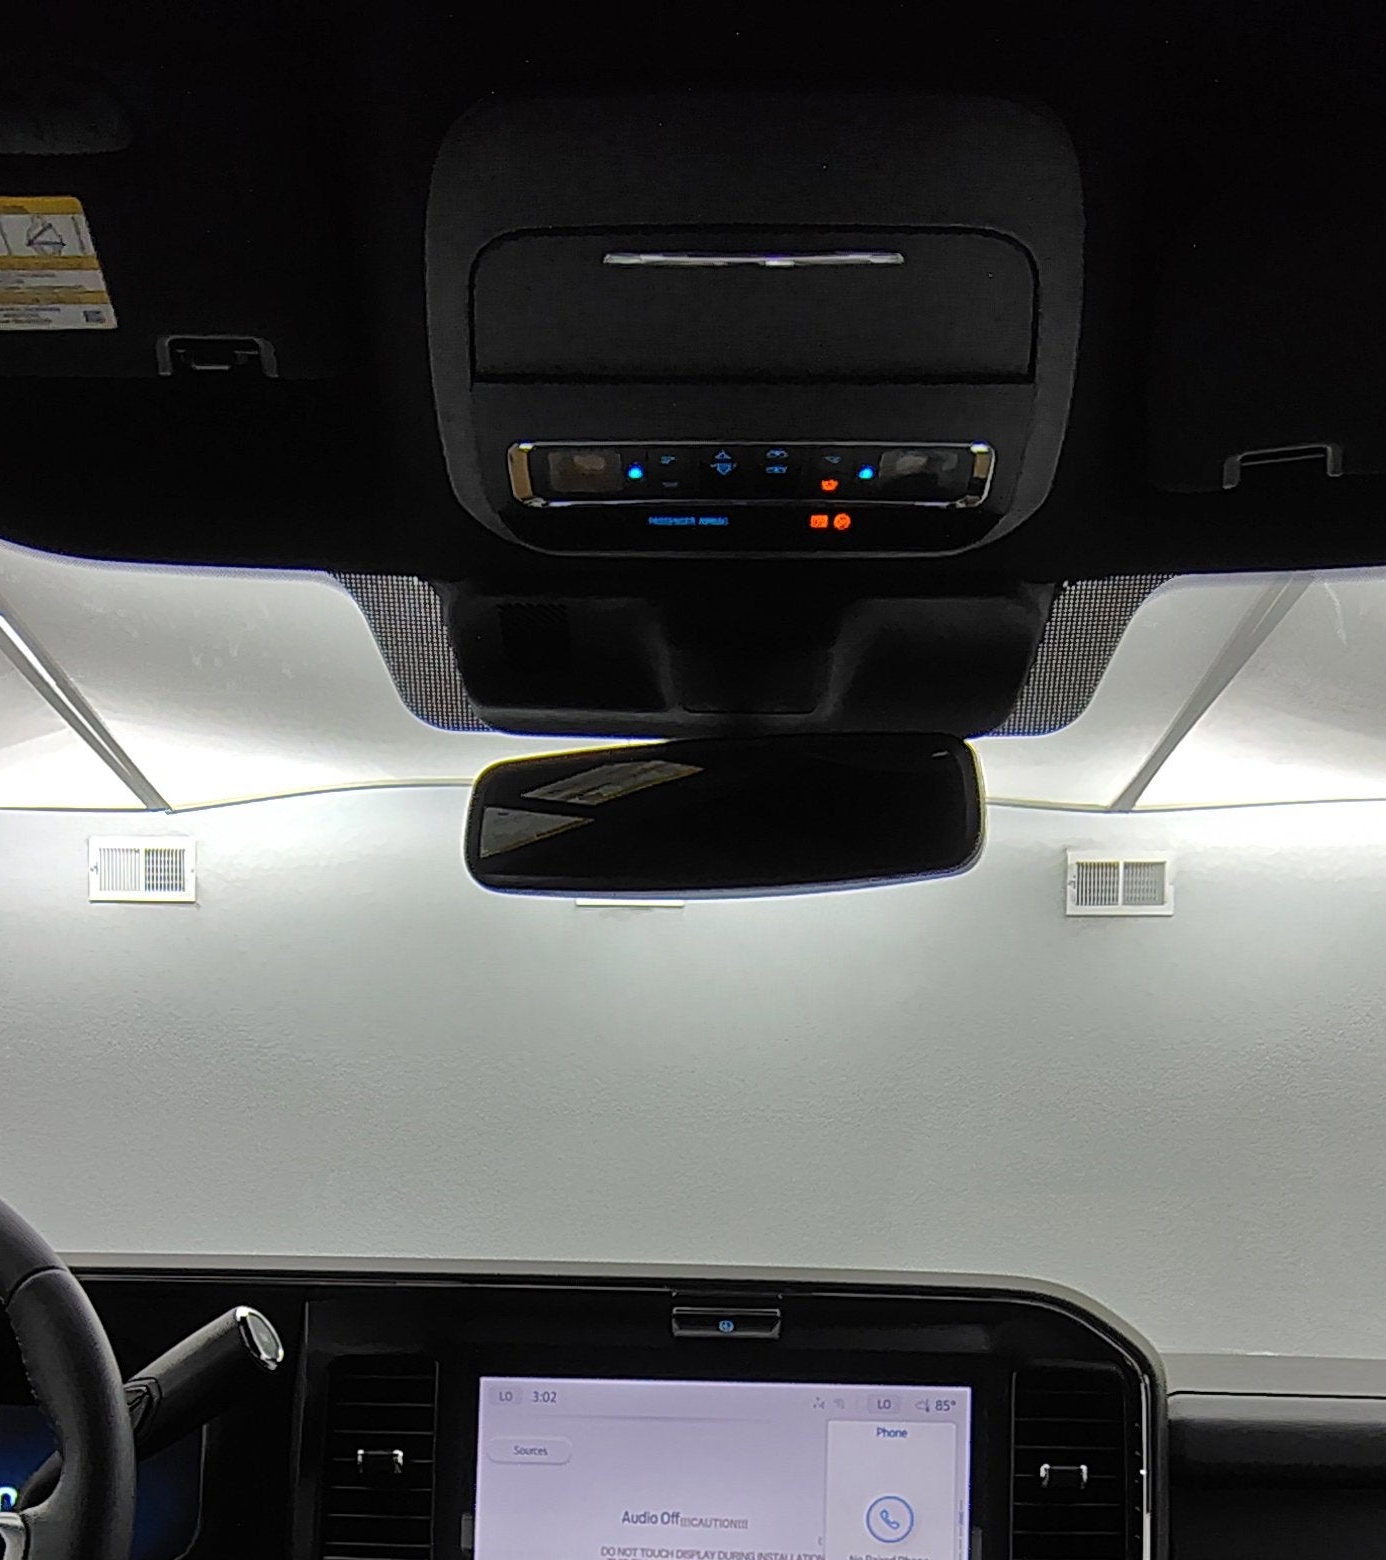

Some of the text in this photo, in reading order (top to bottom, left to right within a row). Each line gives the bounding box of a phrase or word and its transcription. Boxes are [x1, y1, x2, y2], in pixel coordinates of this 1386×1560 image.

[533, 1390, 557, 1403] 3:02
[876, 1427, 908, 1438] Phone
[513, 1445, 549, 1456] Sources
[621, 1511, 680, 1525] Audio Off
[601, 1546, 616, 1557] DO
[617, 1547, 638, 1558] NOT
[640, 1548, 675, 1559] TOUCH
[676, 1549, 717, 1560] DISPLAY
